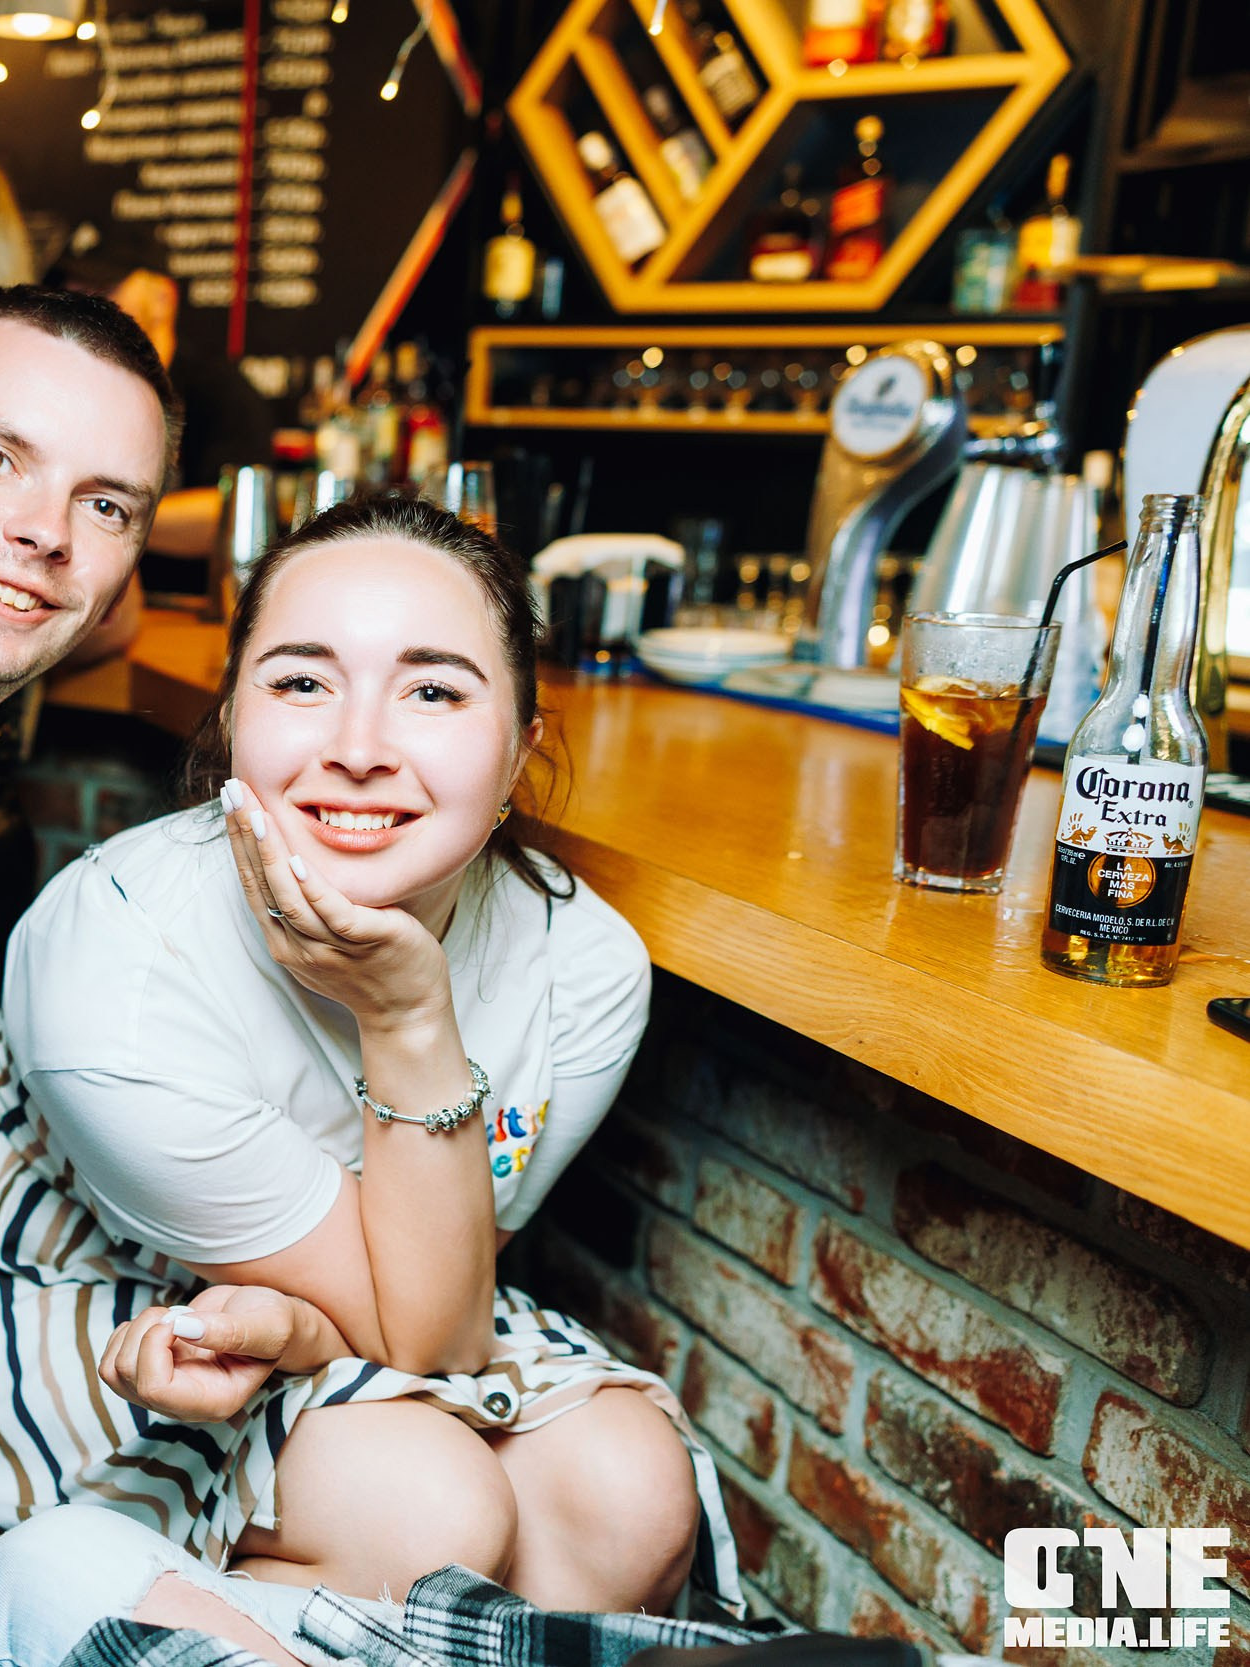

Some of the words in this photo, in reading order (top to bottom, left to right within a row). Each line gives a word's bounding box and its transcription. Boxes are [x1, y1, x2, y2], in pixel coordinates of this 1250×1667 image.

[1076, 766, 1190, 805] Corona
[1101, 800, 1167, 827] Extra
[1116, 862, 1133, 872] LA
[1097, 869, 1150, 882] CERVEZA
[1109, 880, 1135, 890] MAS
[1107, 889, 1134, 899] FINA
[1055, 903, 1092, 919] CERVECERIA
[1126, 917, 1134, 926] S.
[1135, 918, 1145, 927] DE
[1099, 923, 1129, 935] MEXICO
